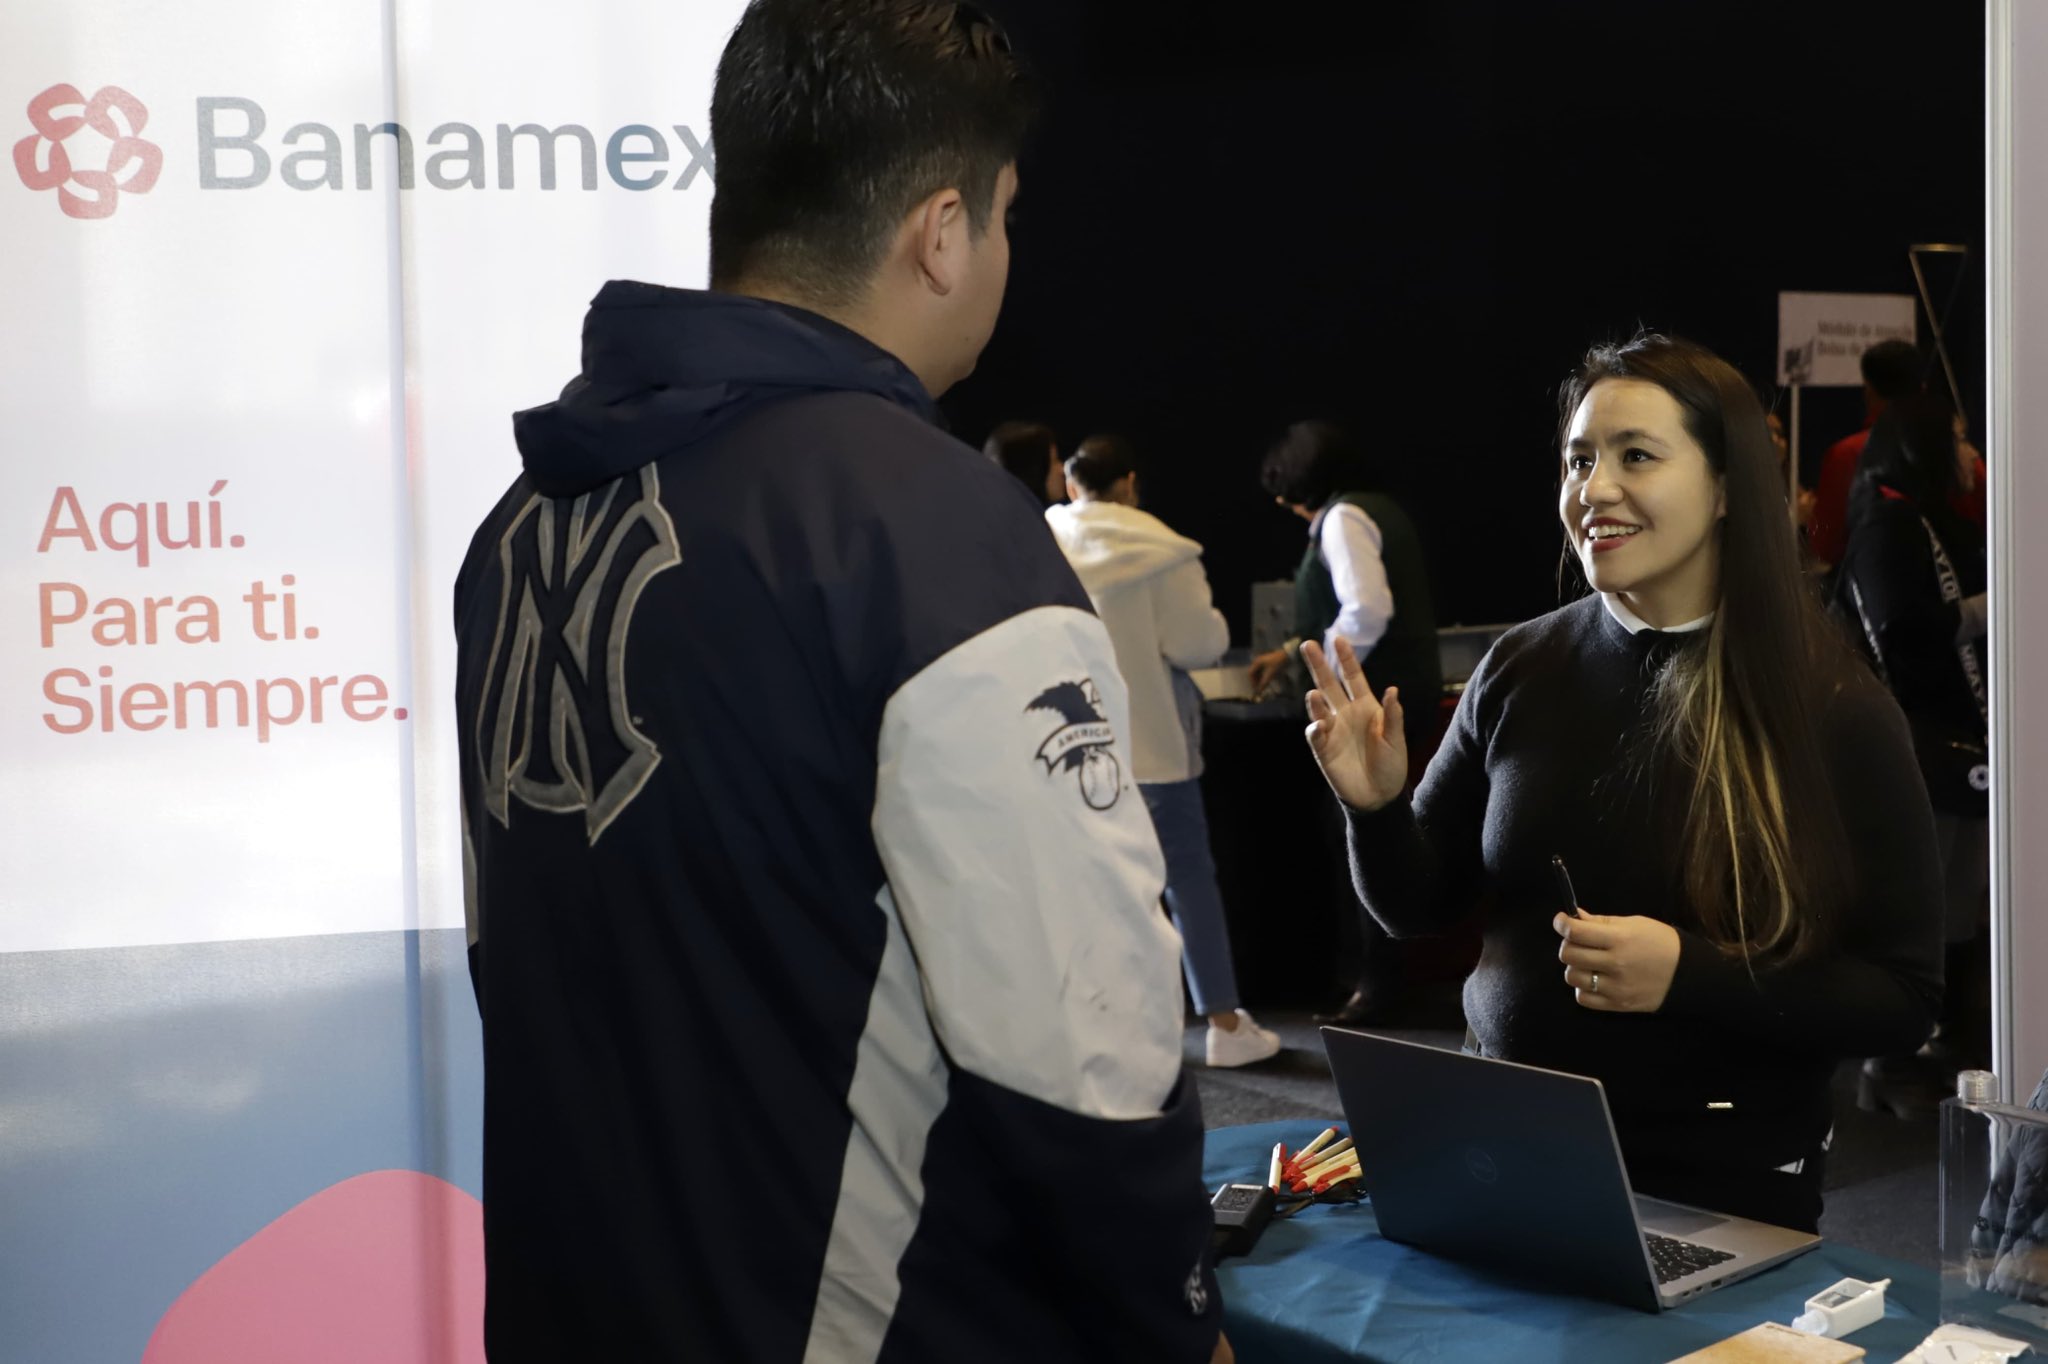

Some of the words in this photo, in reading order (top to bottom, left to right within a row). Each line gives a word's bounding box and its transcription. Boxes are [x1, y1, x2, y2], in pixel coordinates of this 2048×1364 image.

[196, 96, 715, 191] Banamex
[37, 479, 246, 567] Aquí.
[39, 581, 221, 648] Para
[242, 573, 320, 642] ti.
[42, 664, 408, 743] Siempre.
